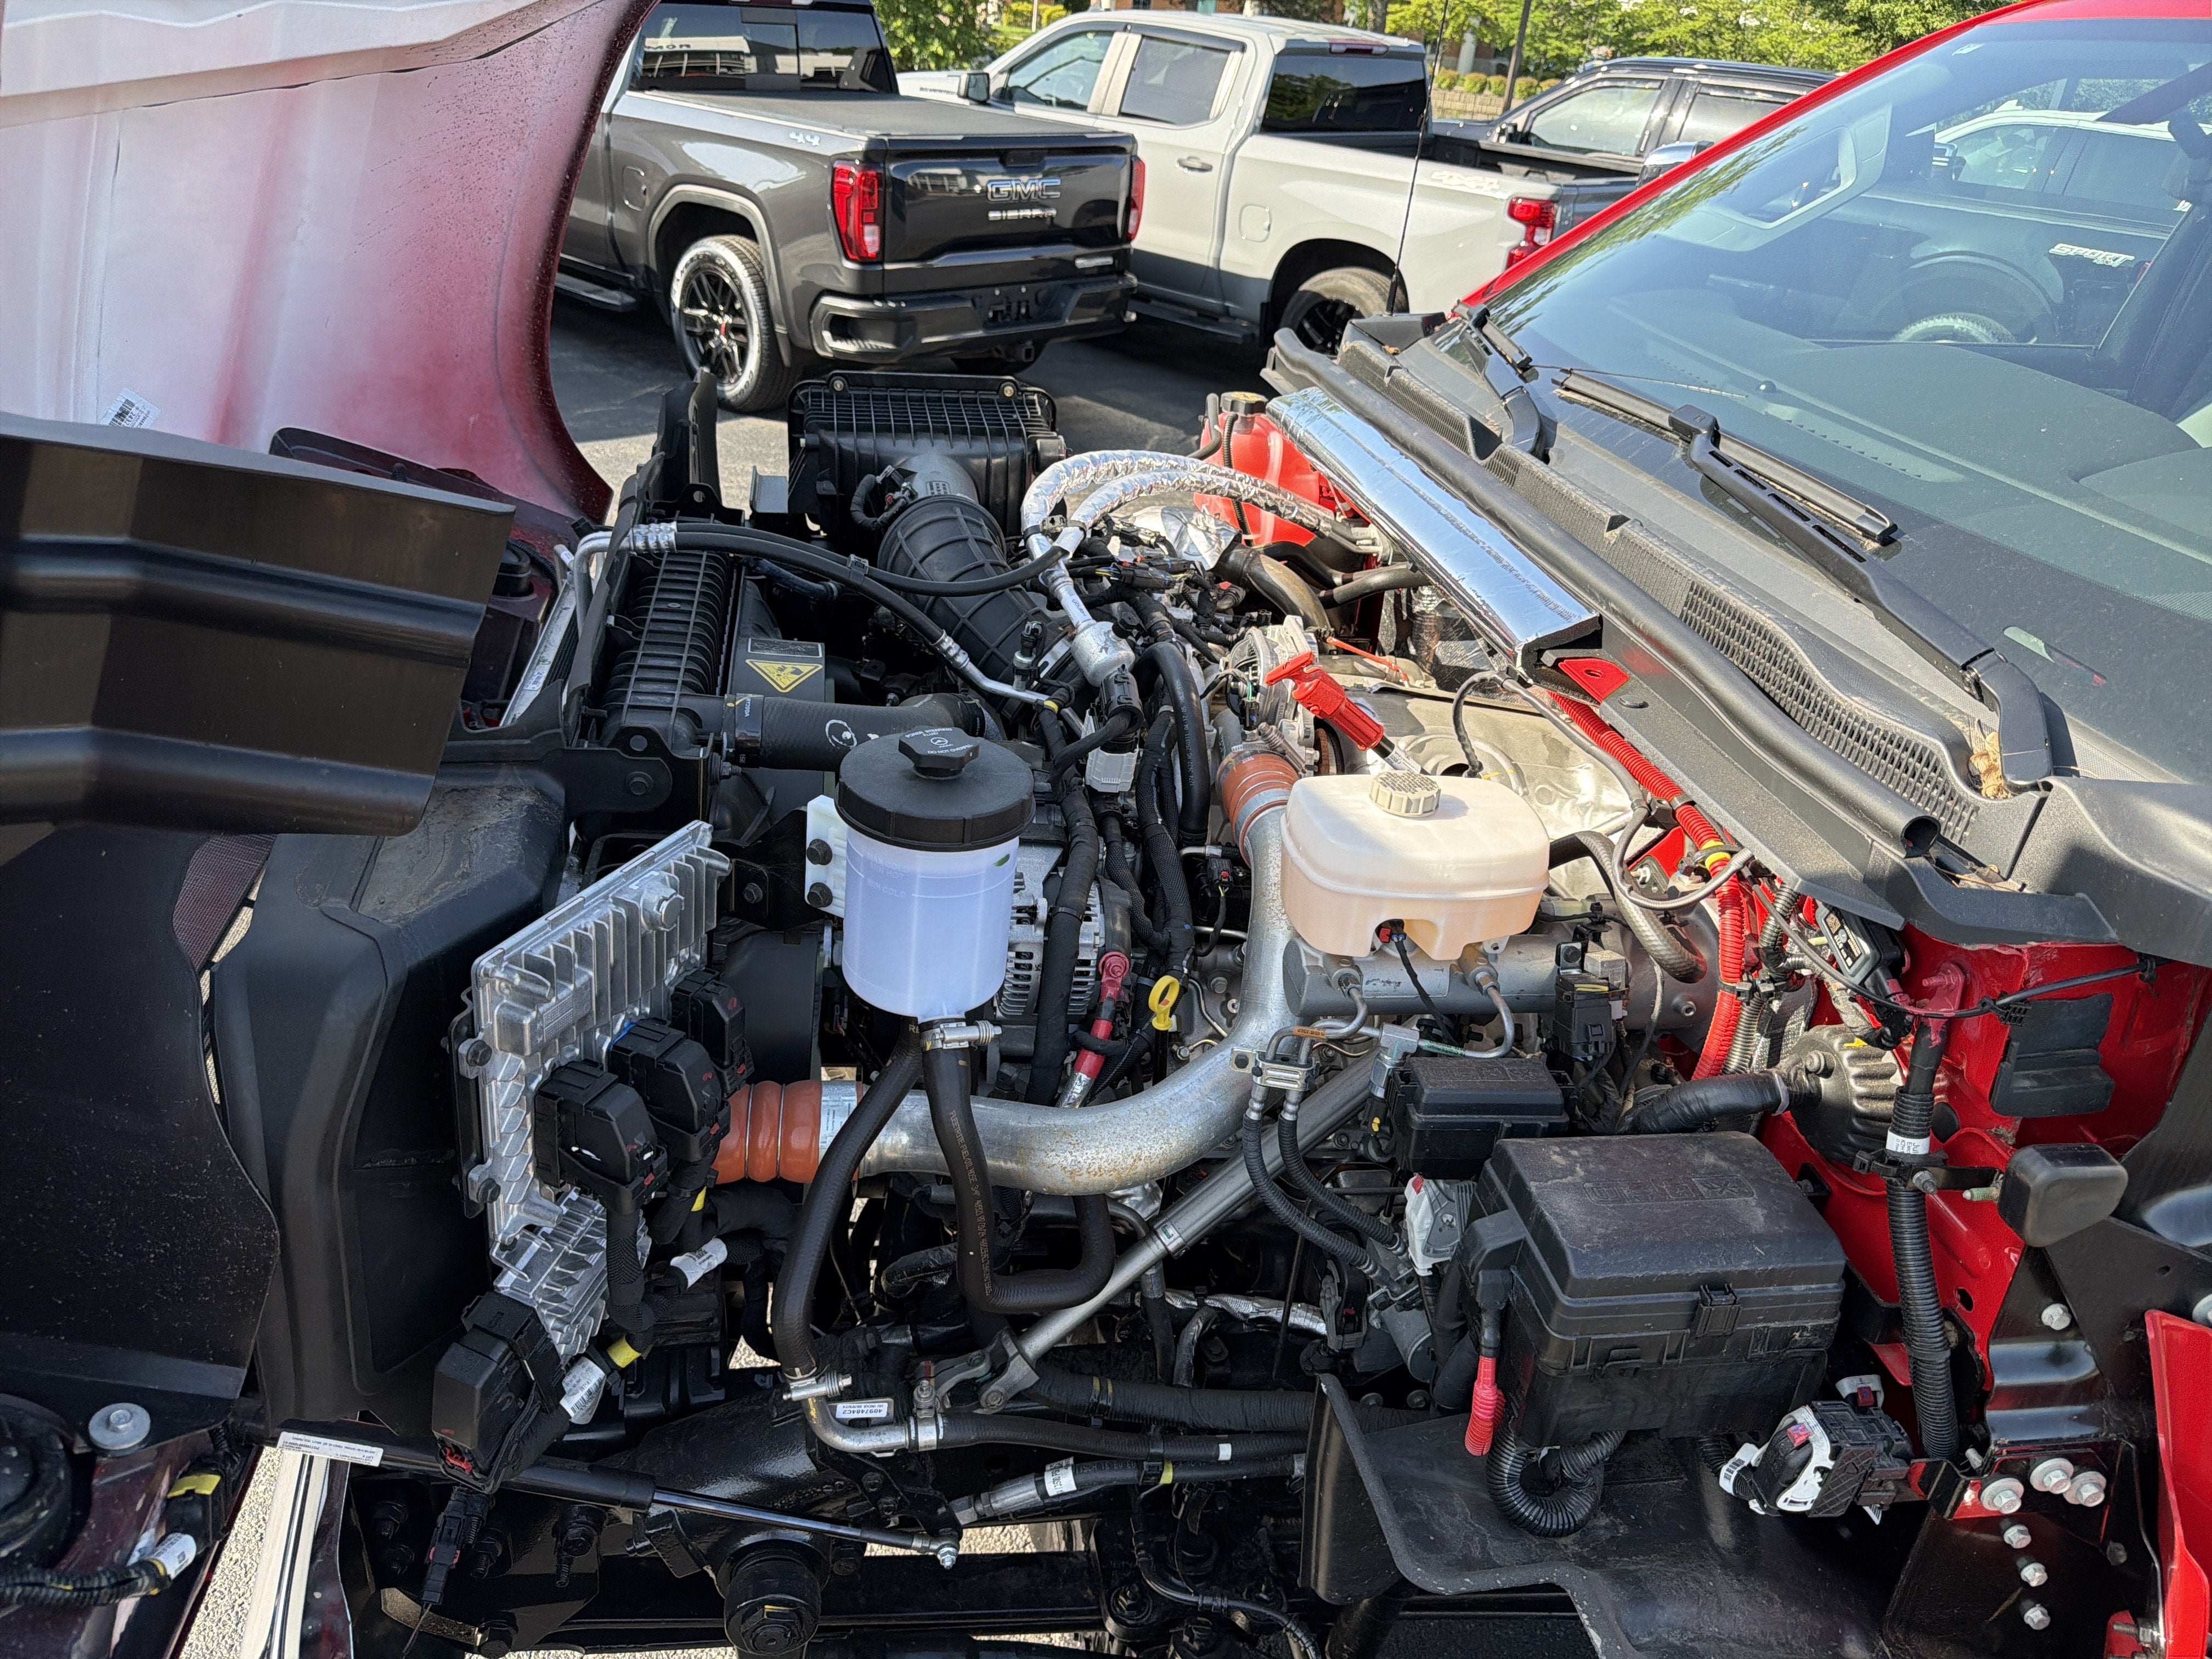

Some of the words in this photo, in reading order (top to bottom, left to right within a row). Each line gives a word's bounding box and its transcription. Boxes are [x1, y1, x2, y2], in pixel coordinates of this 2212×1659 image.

[987, 177, 1062, 202] GMC
[988, 208, 1057, 221] SIERRA
[2048, 242, 2135, 261] SPORT
[950, 743, 974, 753] OVERFILL
[967, 1167, 978, 1183] HOSE
